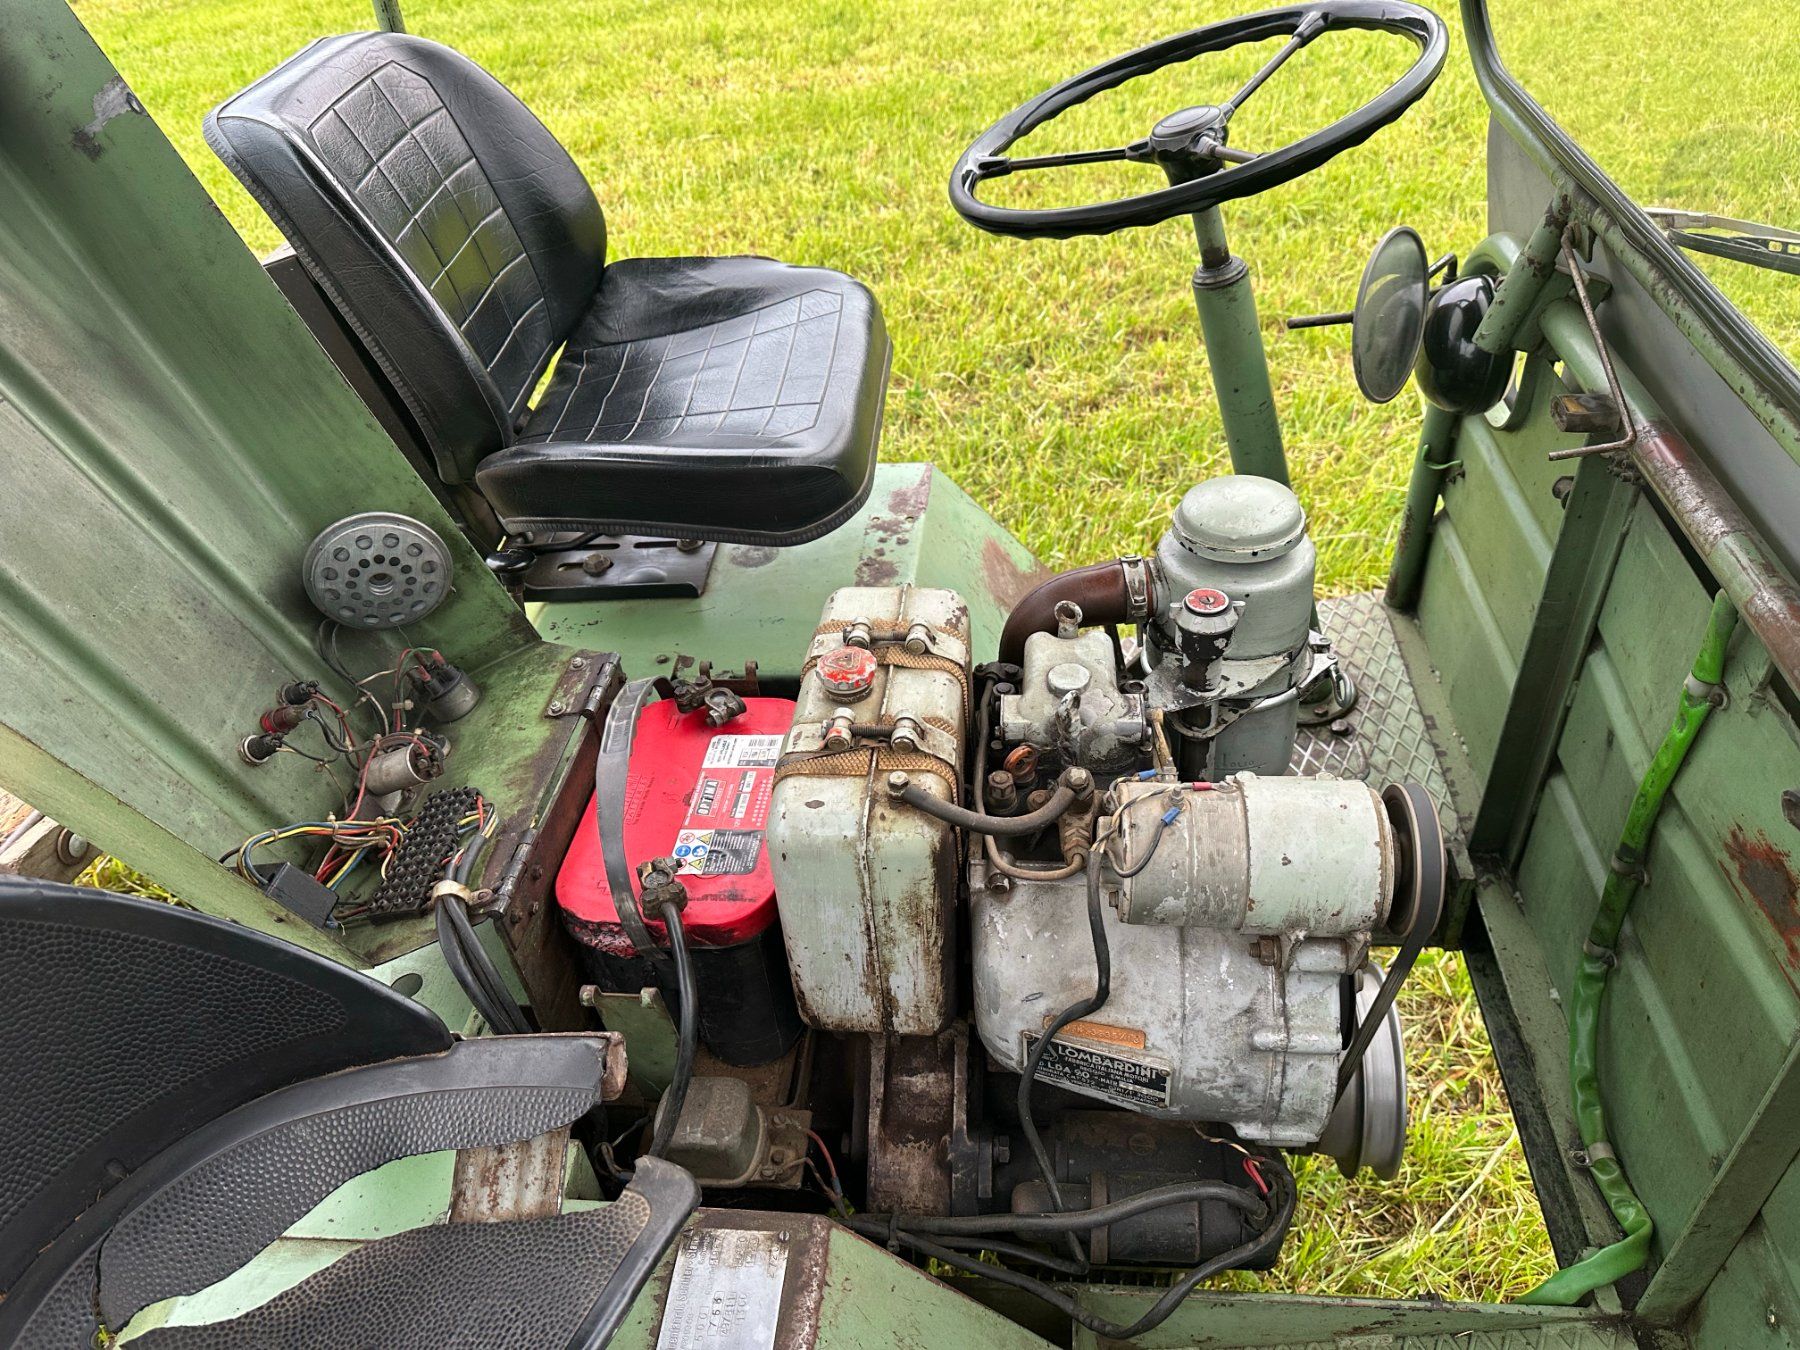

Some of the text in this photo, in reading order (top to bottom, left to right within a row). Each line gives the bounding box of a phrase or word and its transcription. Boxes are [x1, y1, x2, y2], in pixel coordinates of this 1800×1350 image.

[698, 781, 718, 815] OPTIMA
[1047, 1061, 1071, 1073] LDA
[1074, 1068, 1089, 1079] 90
[1058, 1044, 1157, 1079] LOMBARDINI
